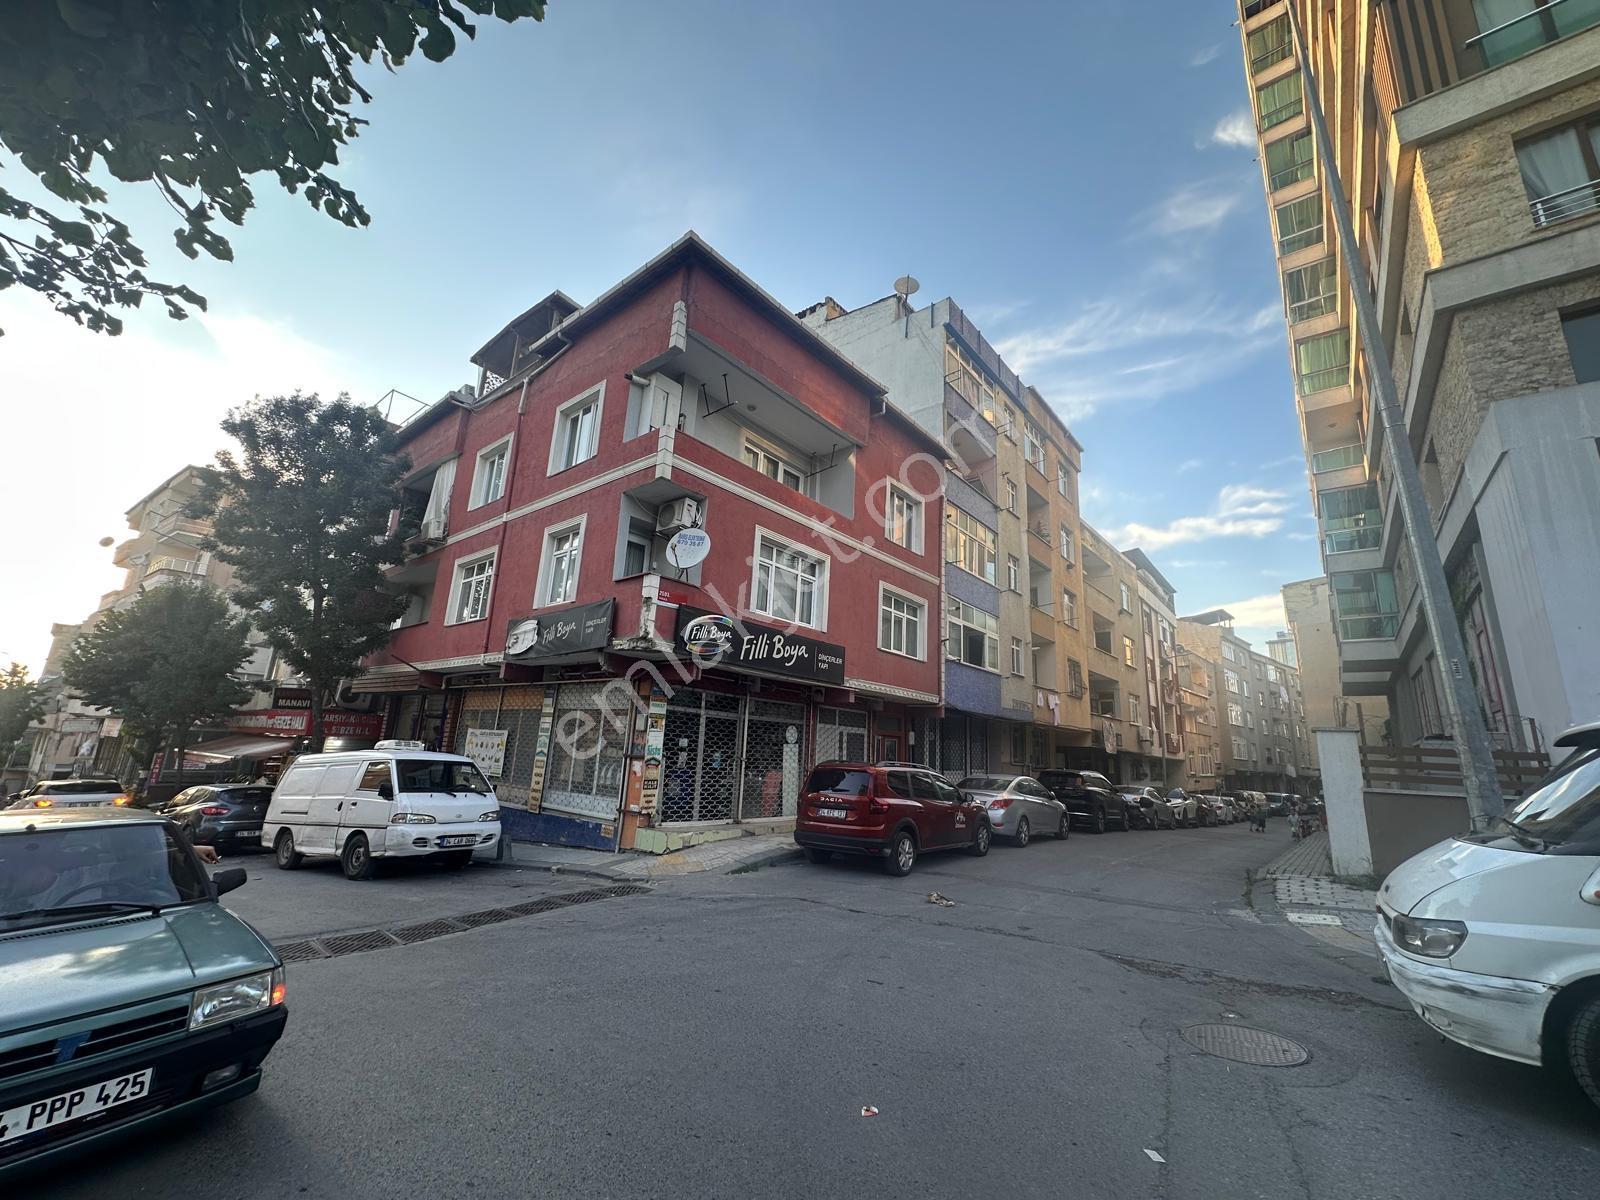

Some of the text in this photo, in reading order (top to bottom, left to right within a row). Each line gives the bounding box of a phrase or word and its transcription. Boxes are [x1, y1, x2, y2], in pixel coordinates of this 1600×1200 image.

[557, 621, 577, 640] Boya
[690, 625, 732, 643] Filli Boya
[740, 633, 809, 666] Filli Boya
[26, 1091, 85, 1130] PPP
[95, 1072, 146, 1107] 425
